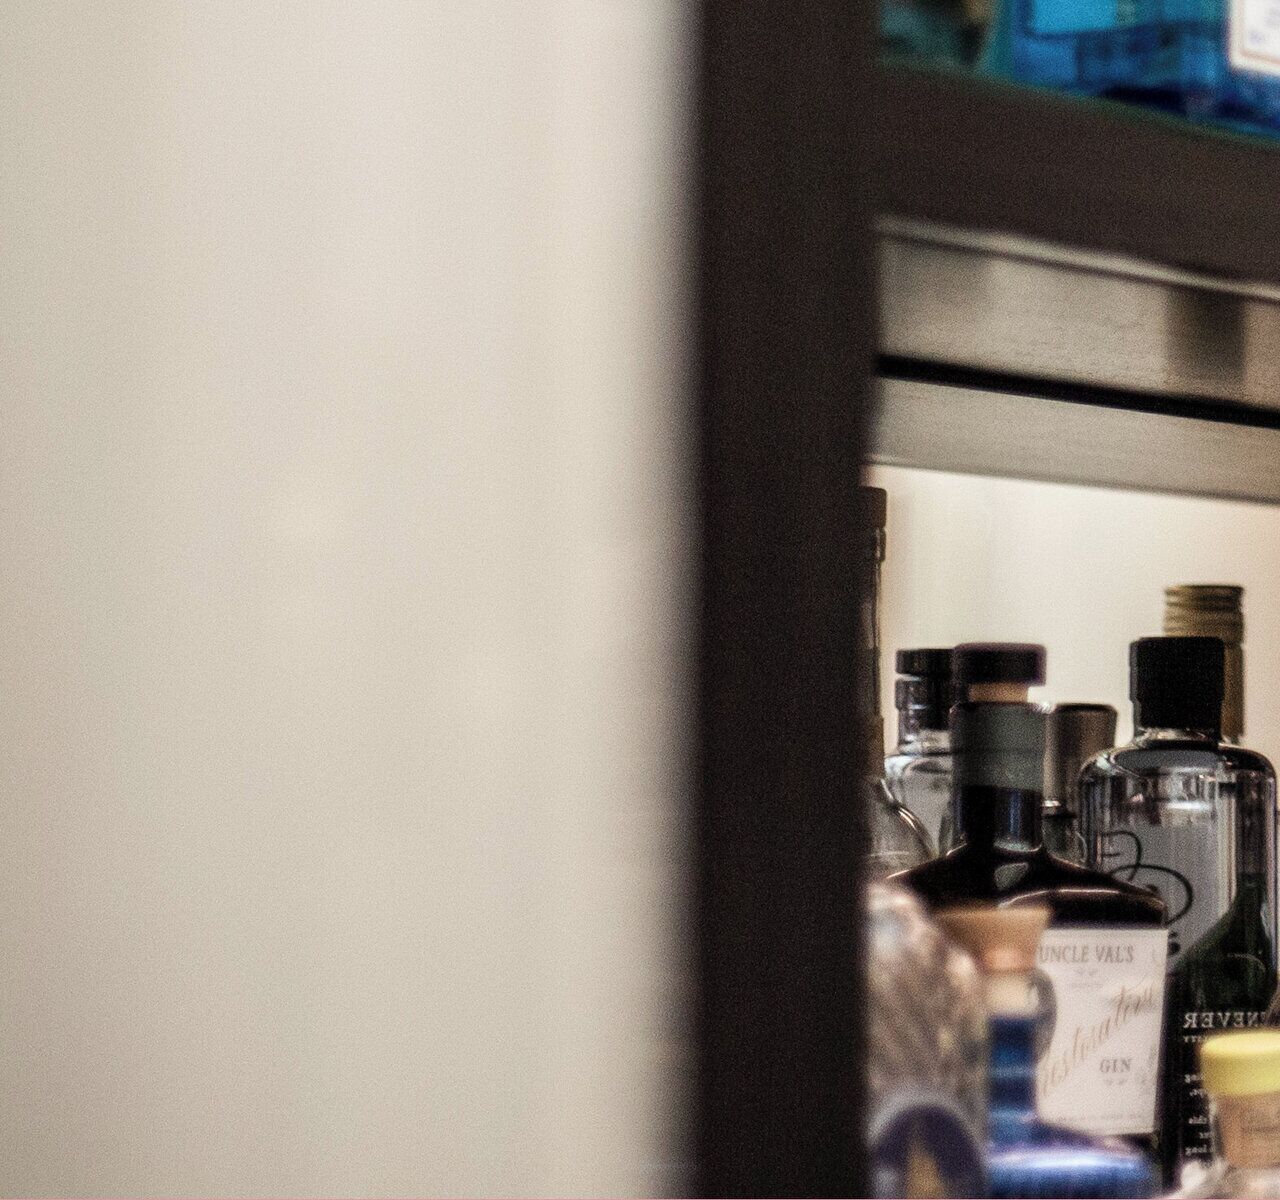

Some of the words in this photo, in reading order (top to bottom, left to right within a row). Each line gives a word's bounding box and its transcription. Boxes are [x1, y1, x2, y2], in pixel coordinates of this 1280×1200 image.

[1038, 943, 1089, 963] UNCLE
[1094, 943, 1134, 963] VAL'S
[1100, 1058, 1132, 1074] GIN
